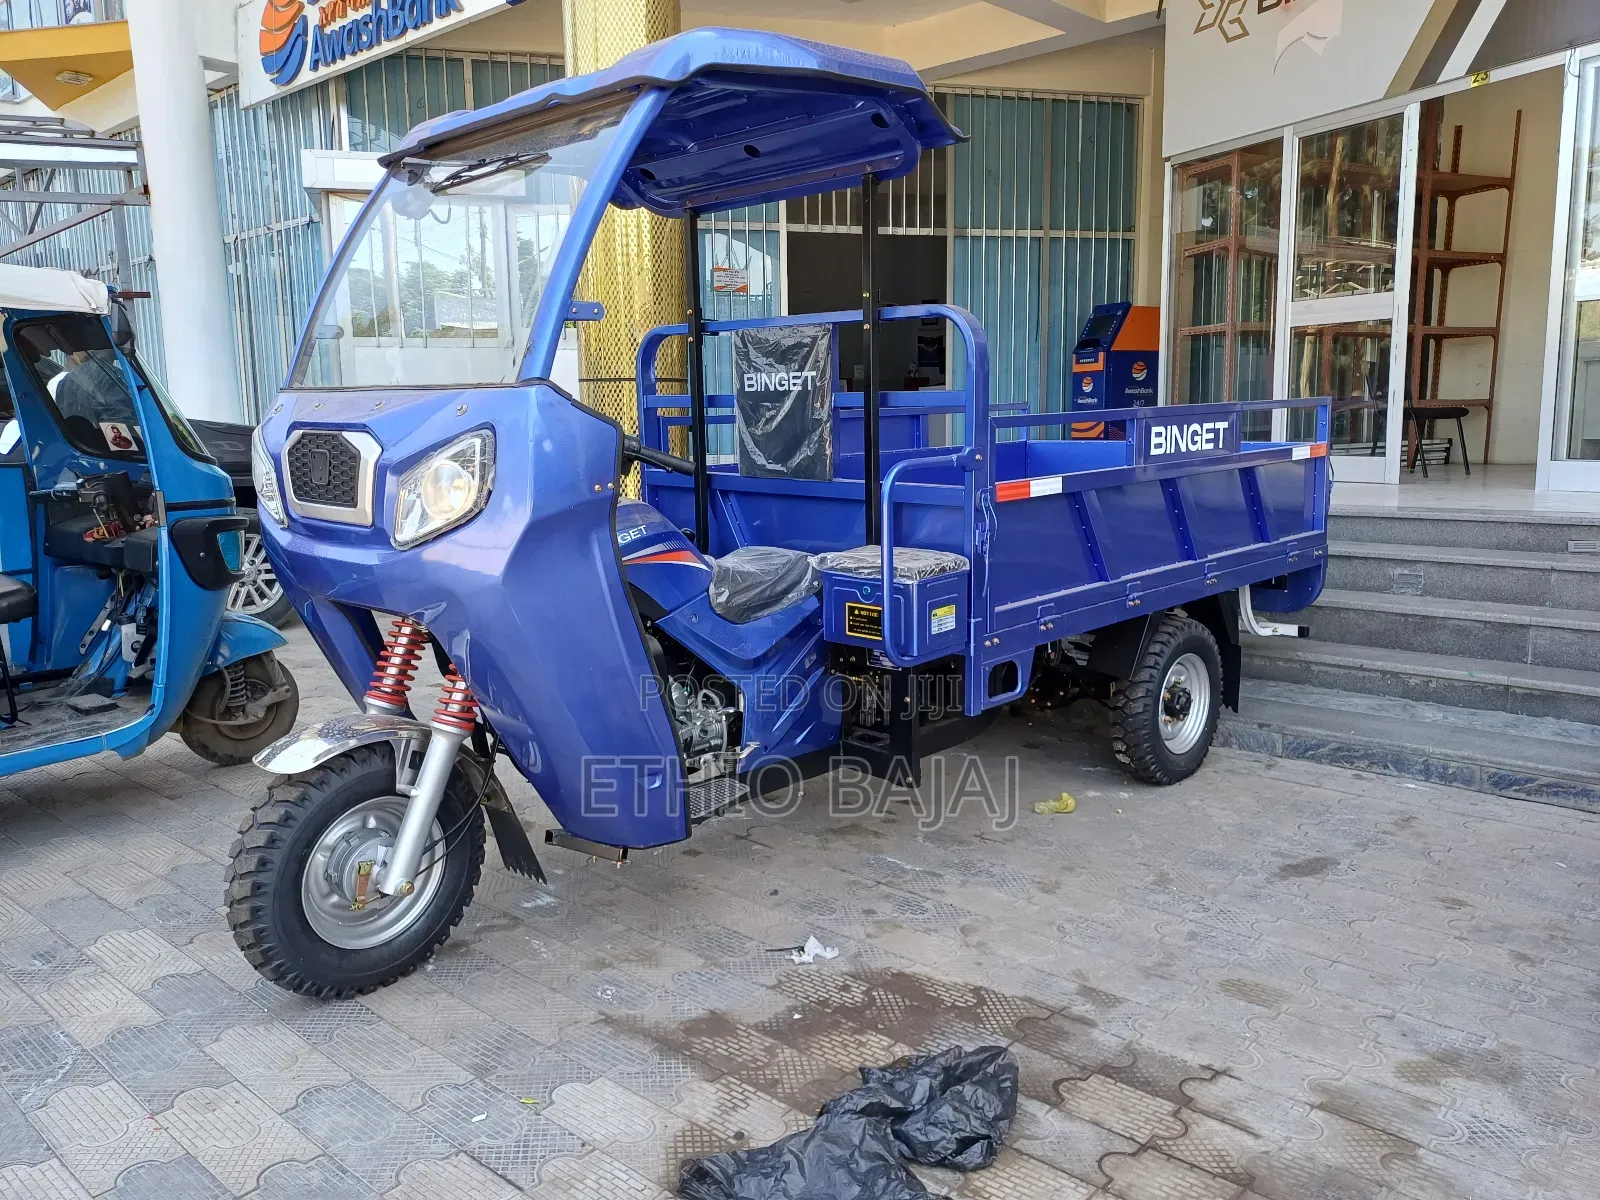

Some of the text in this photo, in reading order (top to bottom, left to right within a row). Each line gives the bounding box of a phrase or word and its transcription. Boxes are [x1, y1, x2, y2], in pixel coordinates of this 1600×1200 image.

[743, 371, 816, 392] BINGET
[1149, 421, 1229, 456] BINGET
[617, 524, 647, 544] GET
